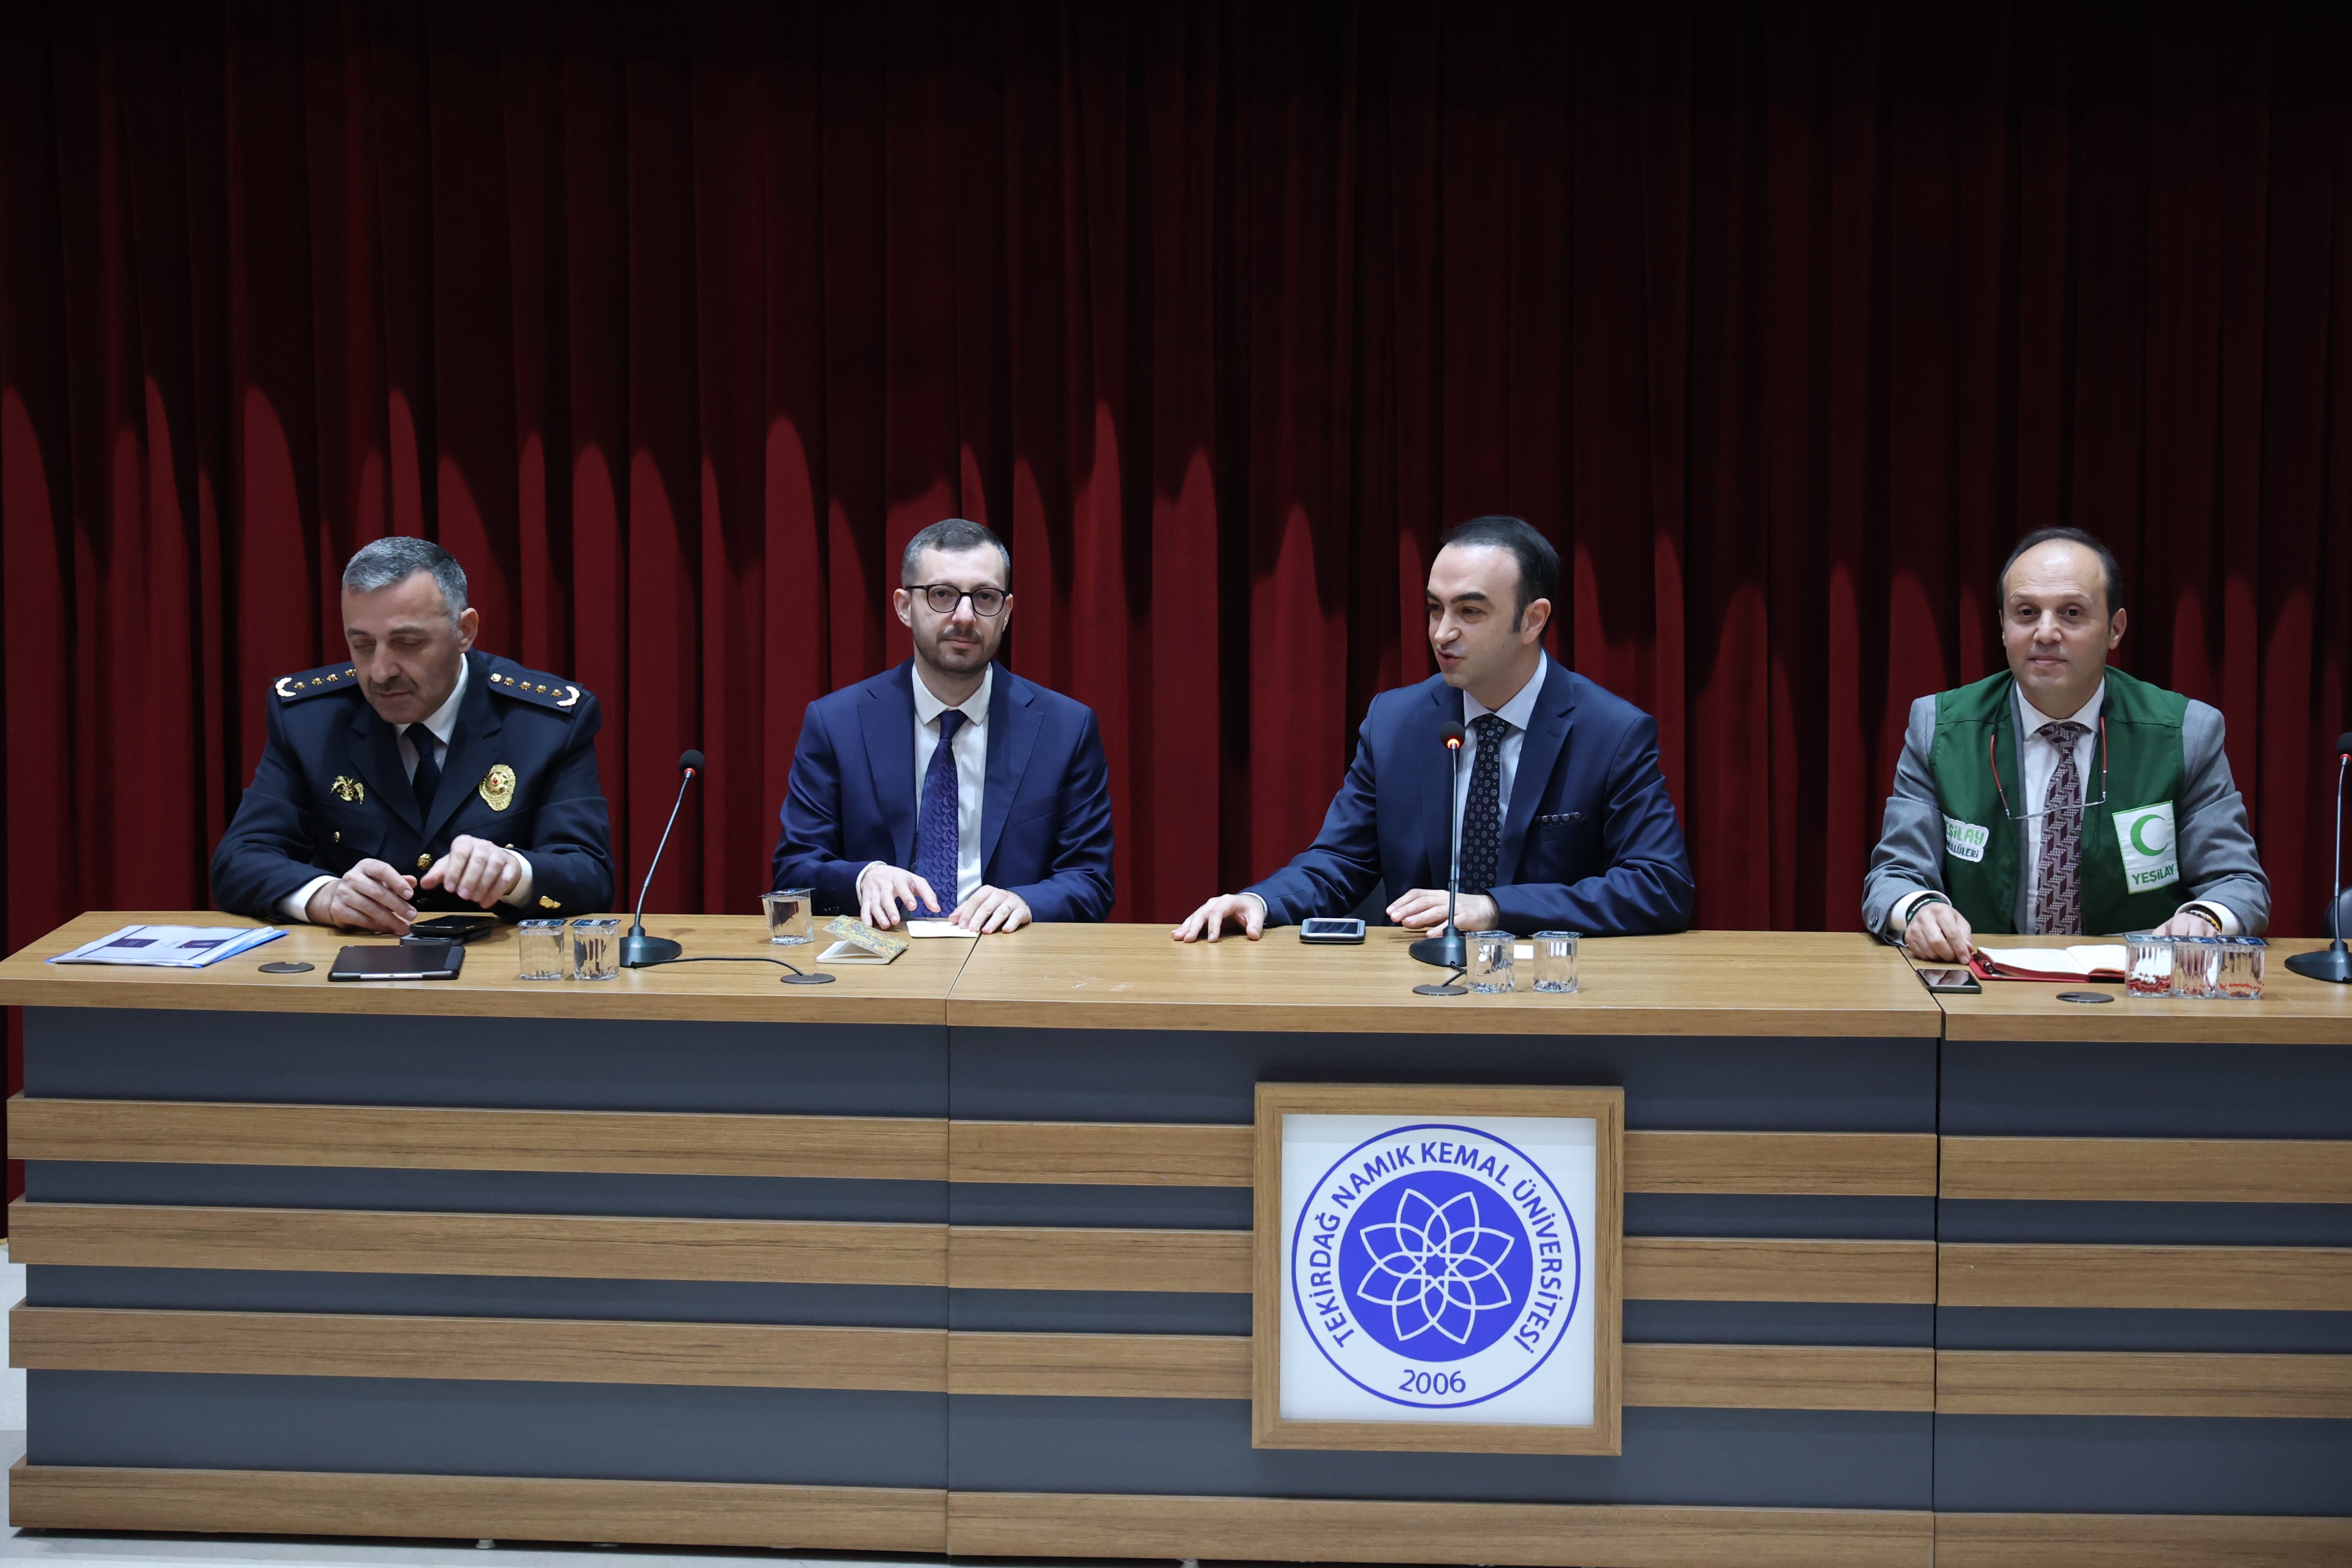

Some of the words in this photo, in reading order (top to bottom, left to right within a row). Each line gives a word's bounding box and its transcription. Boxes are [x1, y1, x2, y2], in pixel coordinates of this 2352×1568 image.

[2131, 863, 2174, 885] YEŞİLAY
[1331, 1145, 1416, 1209] NAMIK
[1421, 1141, 1510, 1187] KEMAL
[1308, 1212, 1355, 1348] TEKİRDAĞ
[1512, 1178, 1564, 1354] ÜNİVERSİTESİ
[1399, 1369, 1466, 1395] 2006
